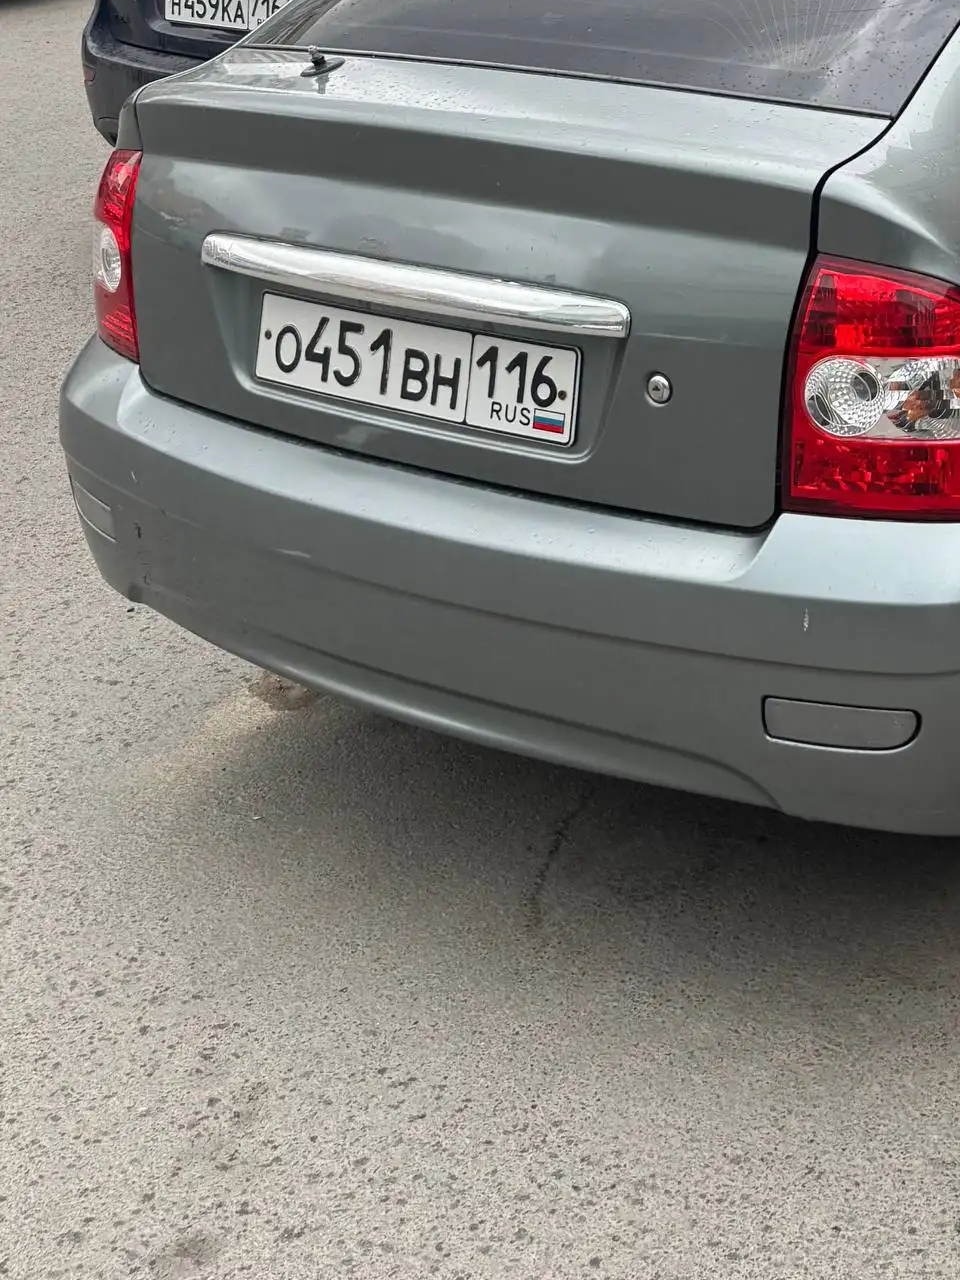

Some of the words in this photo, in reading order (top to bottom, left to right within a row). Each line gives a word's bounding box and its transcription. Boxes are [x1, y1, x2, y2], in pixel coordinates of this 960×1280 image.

[274, 316, 462, 411] О451ВН
[476, 345, 558, 408] 116
[489, 401, 531, 427] RUS
